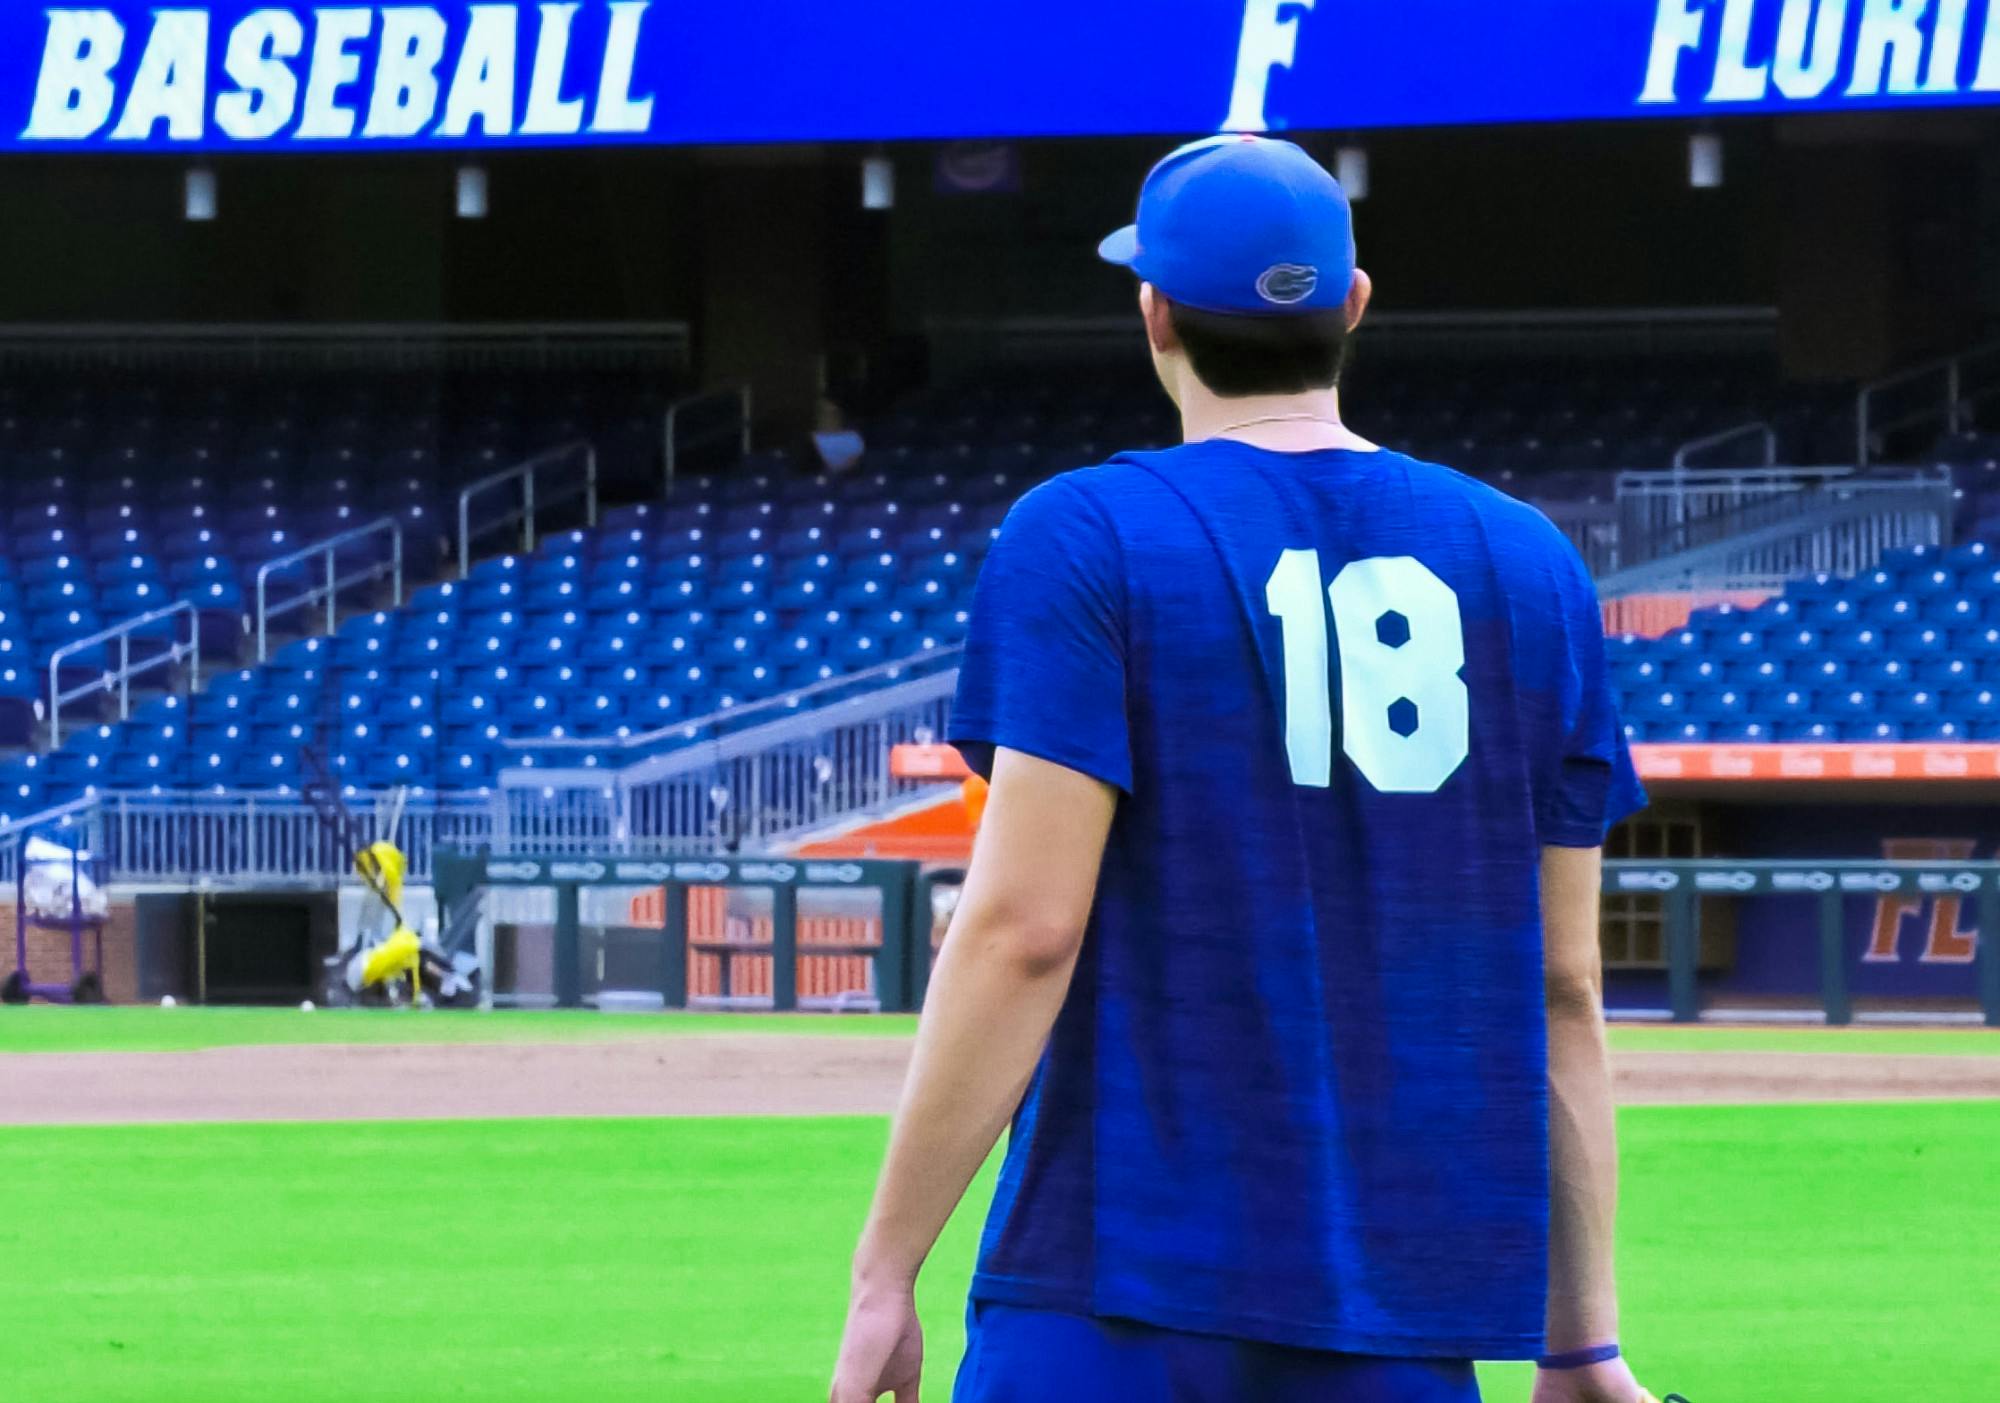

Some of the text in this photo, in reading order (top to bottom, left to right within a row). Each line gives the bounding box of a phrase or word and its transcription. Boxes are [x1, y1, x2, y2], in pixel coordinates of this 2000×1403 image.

[17, 2, 655, 140] BASEBALL
[1218, 0, 1316, 132] F
[1265, 547, 1470, 792] 18
